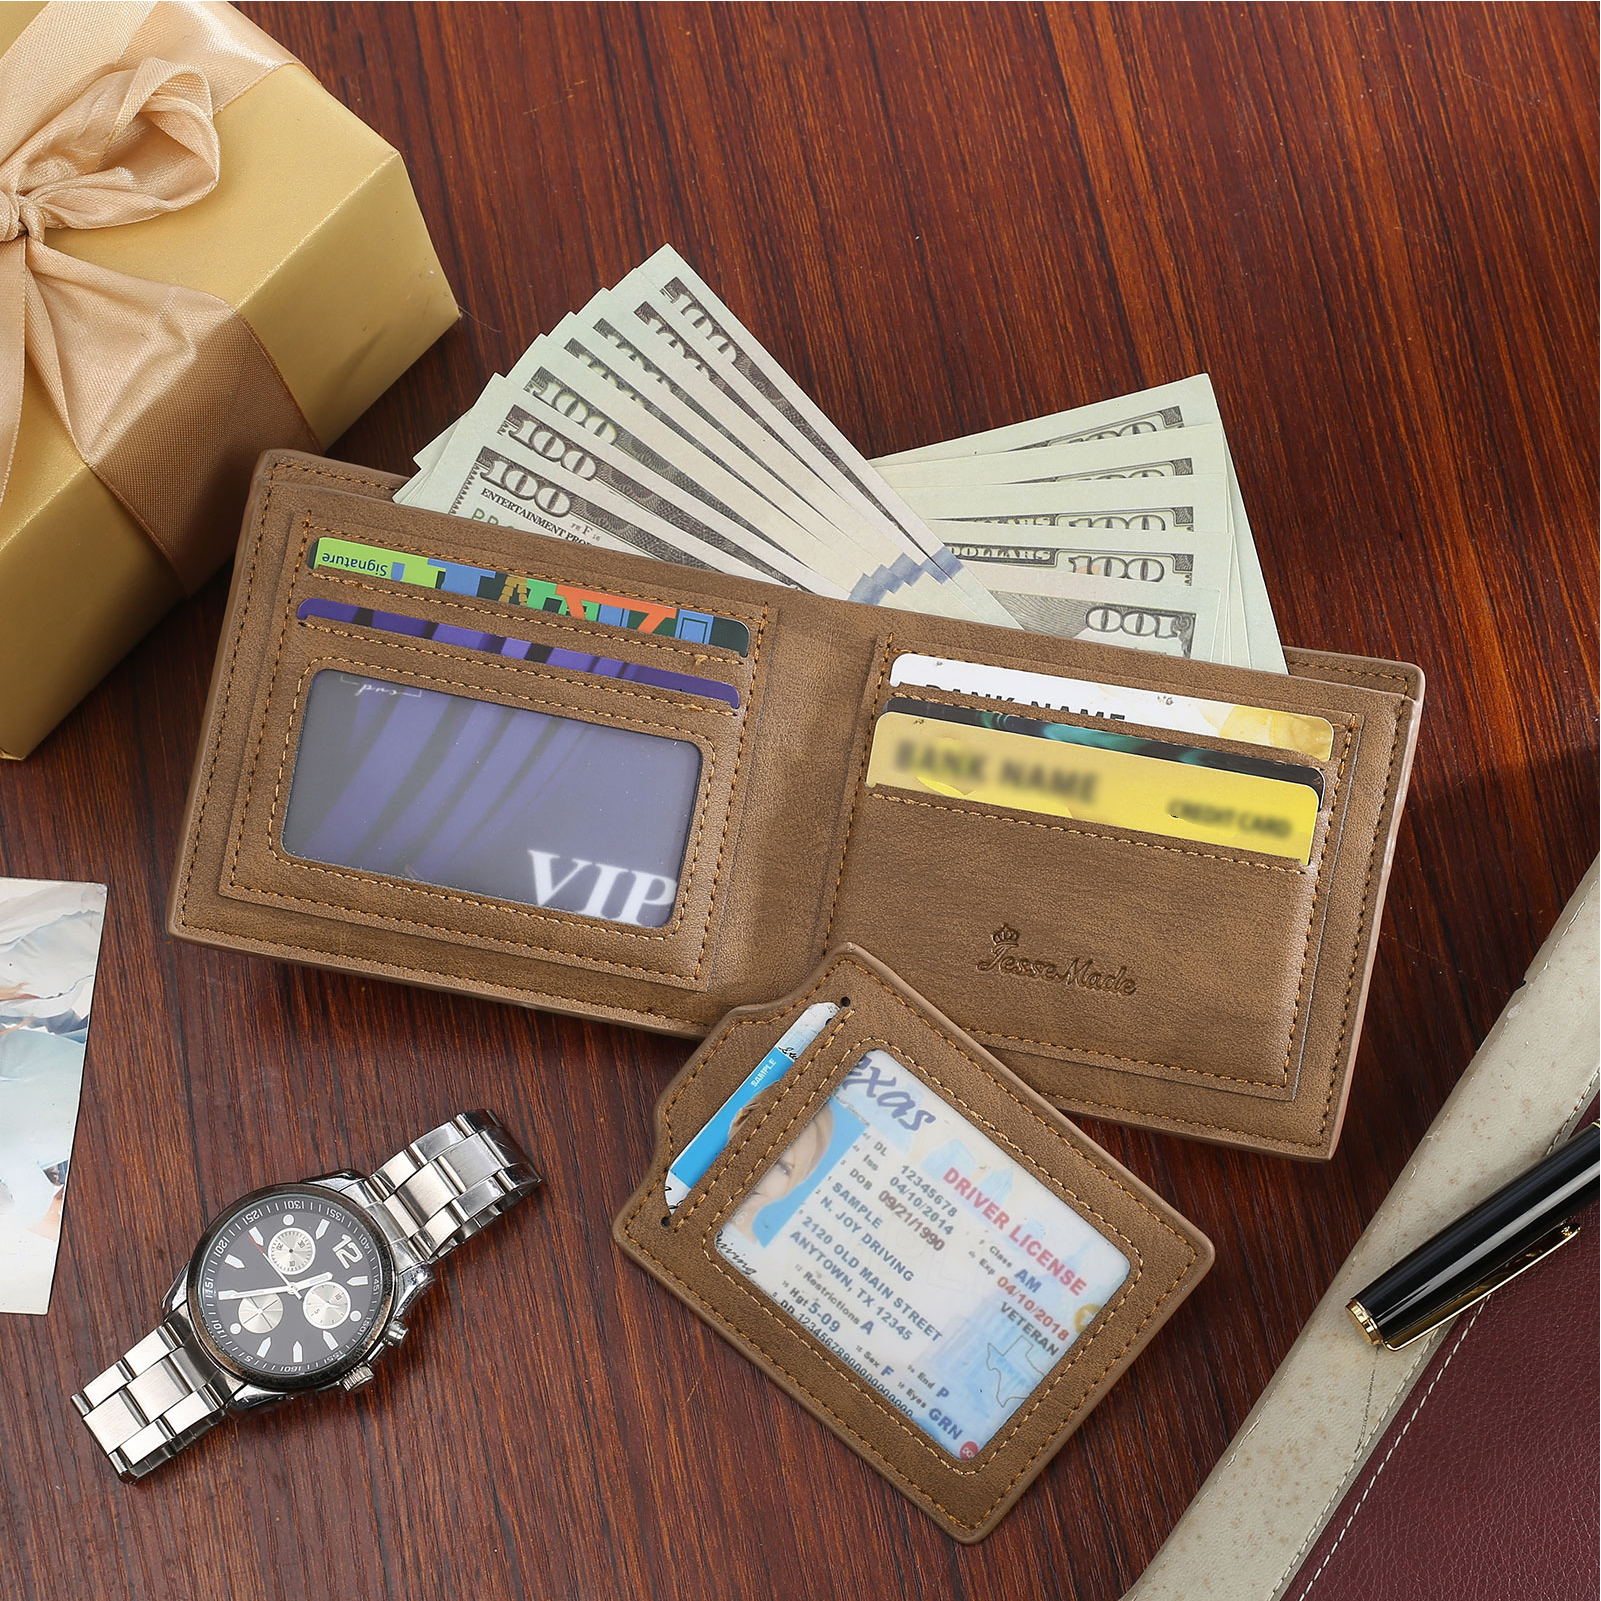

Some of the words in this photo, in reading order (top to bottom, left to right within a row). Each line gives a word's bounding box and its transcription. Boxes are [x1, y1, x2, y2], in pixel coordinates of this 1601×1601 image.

[508, 418, 598, 481] 100
[478, 460, 574, 518] 100
[480, 487, 566, 537] ENTERTAINMENT
[322, 552, 389, 577] Signature
[947, 546, 1051, 562] DOLLARS
[1069, 556, 1165, 583] 100
[527, 849, 678, 926] VIP
[750, 1058, 777, 1087] SAMPLE
[841, 1055, 937, 1132] exas
[830, 1181, 883, 1229] SAMPLE
[861, 1153, 880, 1171] Iss
[887, 1175, 955, 1236] 04/10/2014
[872, 1140, 889, 1157] DL
[897, 1163, 959, 1218] 12345678
[819, 1195, 836, 1212] N.
[833, 1208, 862, 1235] JOY
[859, 1232, 916, 1282] DRIVING
[848, 1167, 874, 1191] DOB
[875, 1188, 947, 1252] 09/21/1990
[941, 1166, 1012, 1230] DRIVER
[1007, 1224, 1088, 1296] LICENSE
[332, 1234, 363, 1269] 12
[800, 1215, 834, 1245] 2120
[831, 1243, 860, 1269] OLD
[858, 1266, 894, 1299] MAIN
[890, 1296, 943, 1343] STREET
[988, 1245, 1013, 1268] Class
[1013, 1266, 1042, 1293] AM
[787, 1229, 857, 1292] ANYTOWN,
[854, 1287, 875, 1307] TX
[873, 1304, 913, 1341] 12345
[787, 1286, 810, 1308] Hgt
[806, 1301, 842, 1334] 5-09
[801, 1270, 862, 1325] Restrictions
[859, 1318, 877, 1335] A
[977, 1257, 996, 1276] Exp
[994, 1274, 1070, 1342] 04/10/2018
[998, 1301, 1059, 1356] VETERAN
[862, 1350, 881, 1368] Sex
[880, 1364, 894, 1379] F
[916, 1371, 935, 1389] End
[935, 1386, 950, 1401] P
[904, 1387, 928, 1409] Eyes
[925, 1405, 963, 1440] GRN
